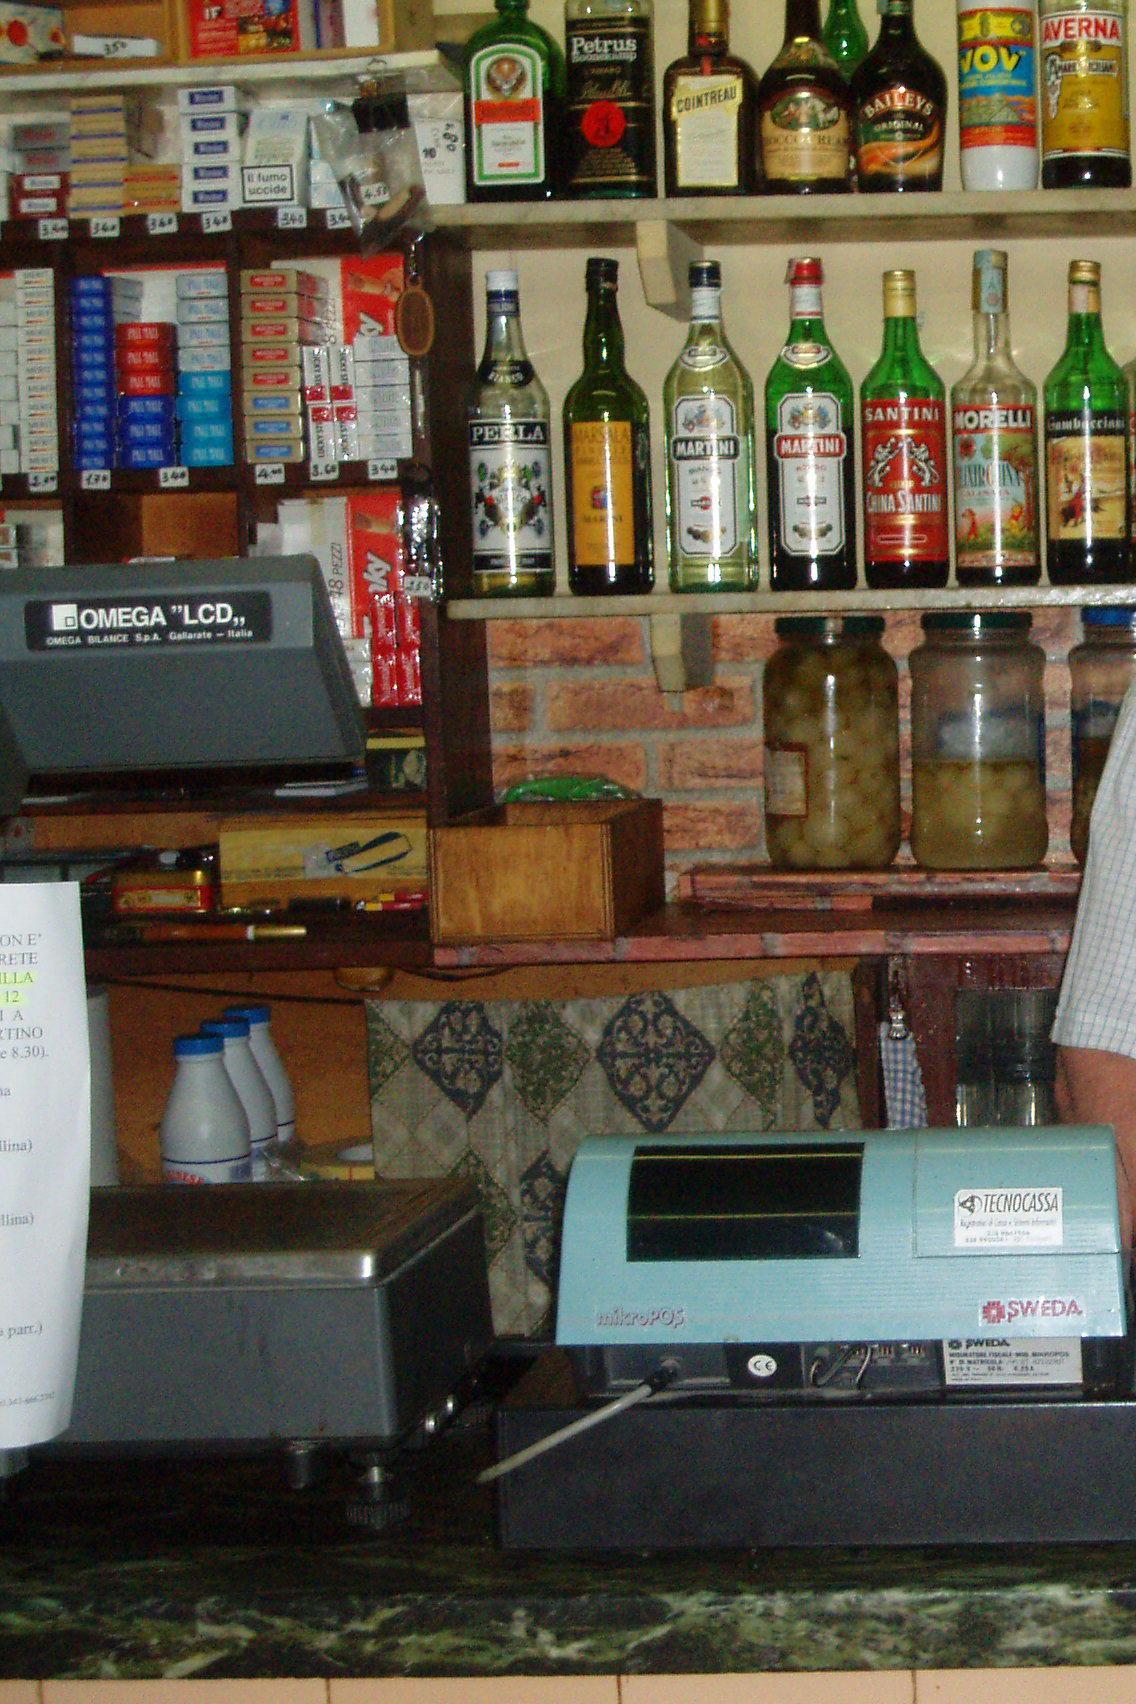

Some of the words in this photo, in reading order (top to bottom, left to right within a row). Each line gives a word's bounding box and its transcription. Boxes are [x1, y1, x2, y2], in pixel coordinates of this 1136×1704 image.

[1043, 16, 1121, 41] AVERNA
[572, 37, 637, 54] Petrus
[677, 85, 738, 114] COINTREAU
[864, 87, 934, 119] BAILEYS
[257, 172, 288, 183] fumo
[250, 184, 288, 196] uccide
[864, 406, 940, 423] SANTINI
[954, 409, 1031, 430] MORELLI
[471, 425, 544, 442] PERLA
[781, 438, 840, 455] MARTINI
[80, 606, 167, 630] OMEGA
[46, 636, 82, 646] OMEGA
[88, 634, 129, 644] BILANCE
[169, 630, 212, 641] Gallarate
[227, 628, 254, 639] Italia
[6, 990, 20, 1003] 12
[13, 1009, 23, 1021] A
[984, 1192, 1059, 1213] TECNOCASSA
[598, 1306, 686, 1329] mikroPOS
[1007, 1299, 1083, 1323] SWEDA
[966, 1338, 1011, 1350] SWEDA
